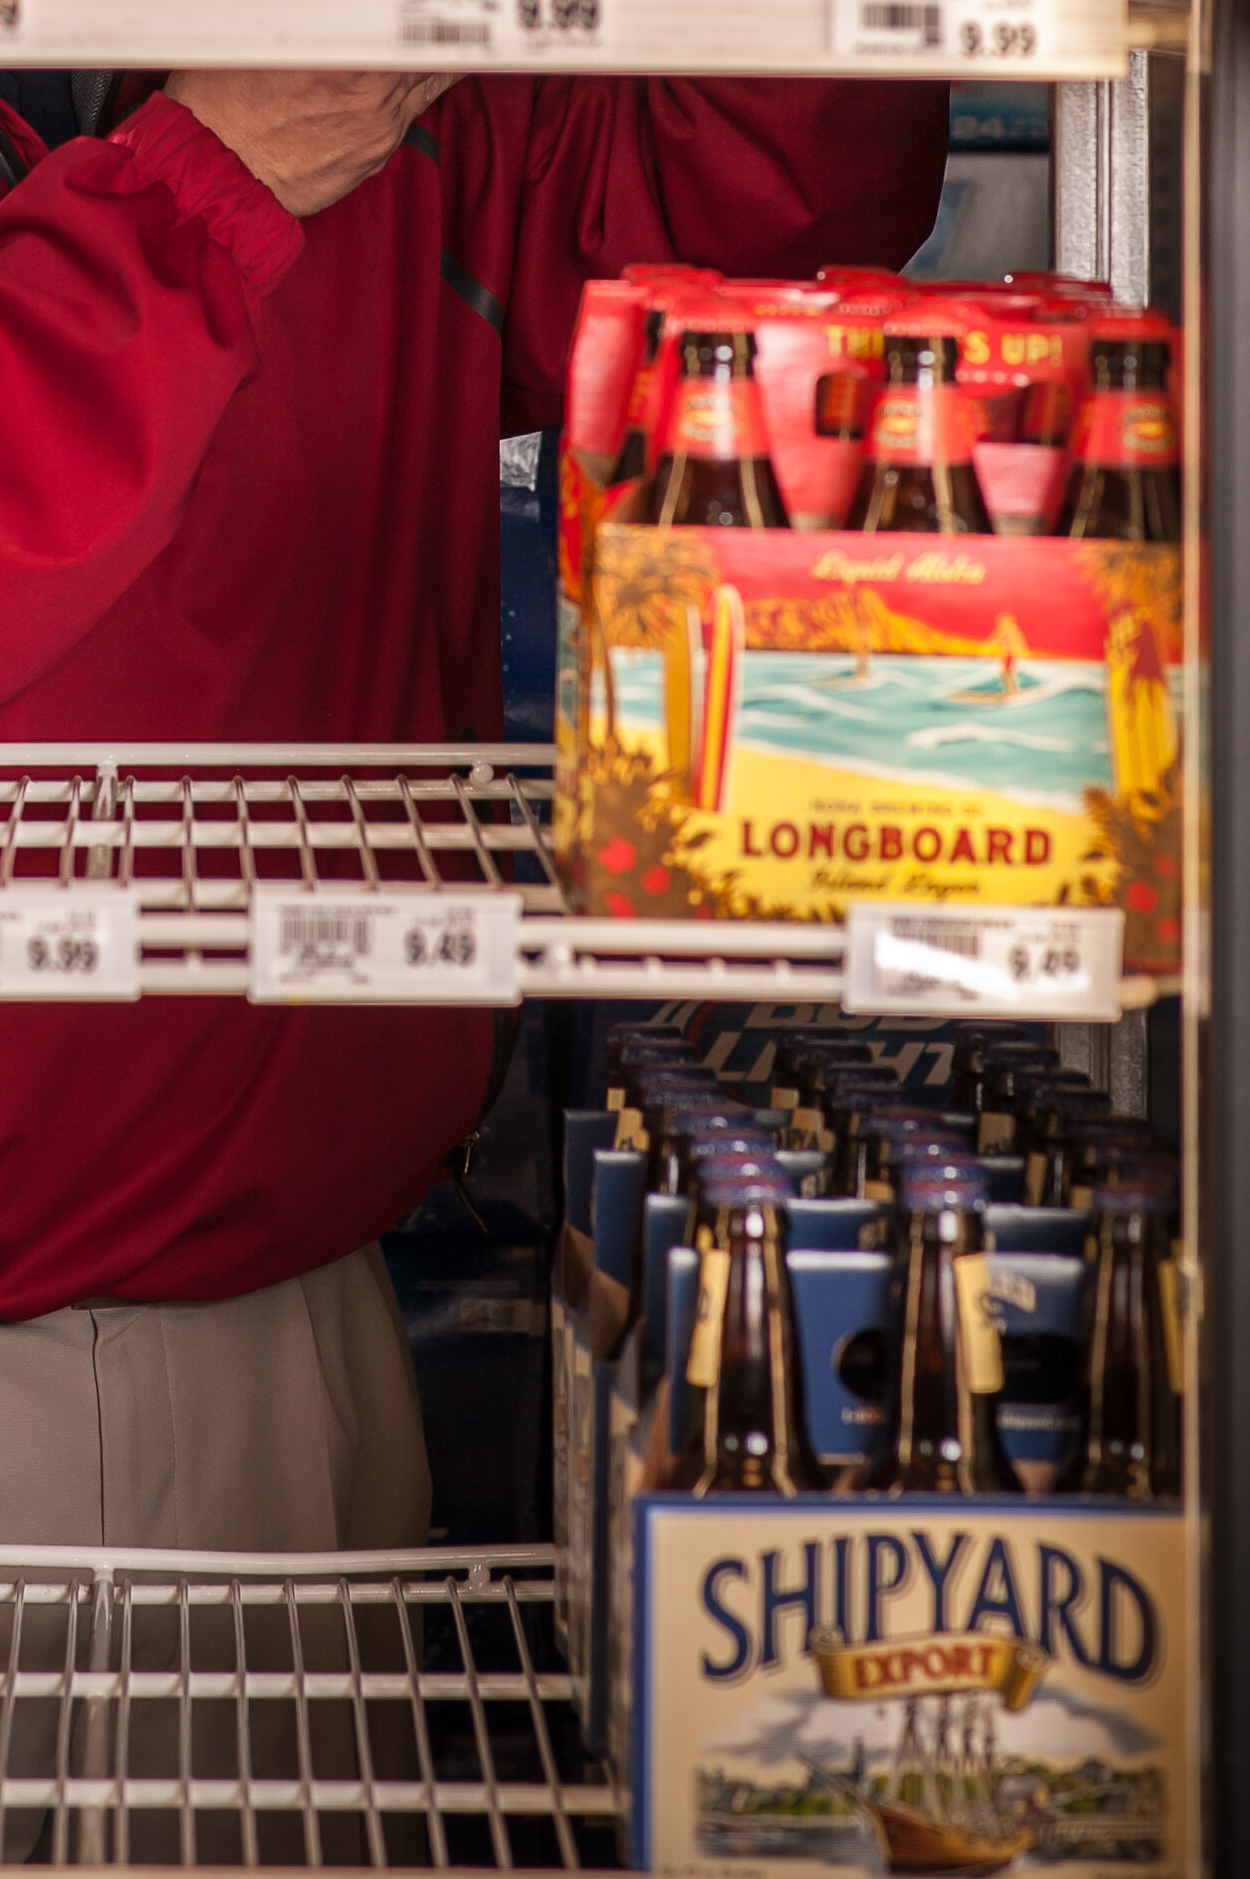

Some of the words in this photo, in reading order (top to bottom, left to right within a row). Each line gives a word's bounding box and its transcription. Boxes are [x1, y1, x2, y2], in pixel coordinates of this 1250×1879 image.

[740, 820, 1052, 866] LONGBOARD
[701, 1528, 1162, 1684] SHIPYARD
[852, 1638, 1002, 1692] EXPORT
